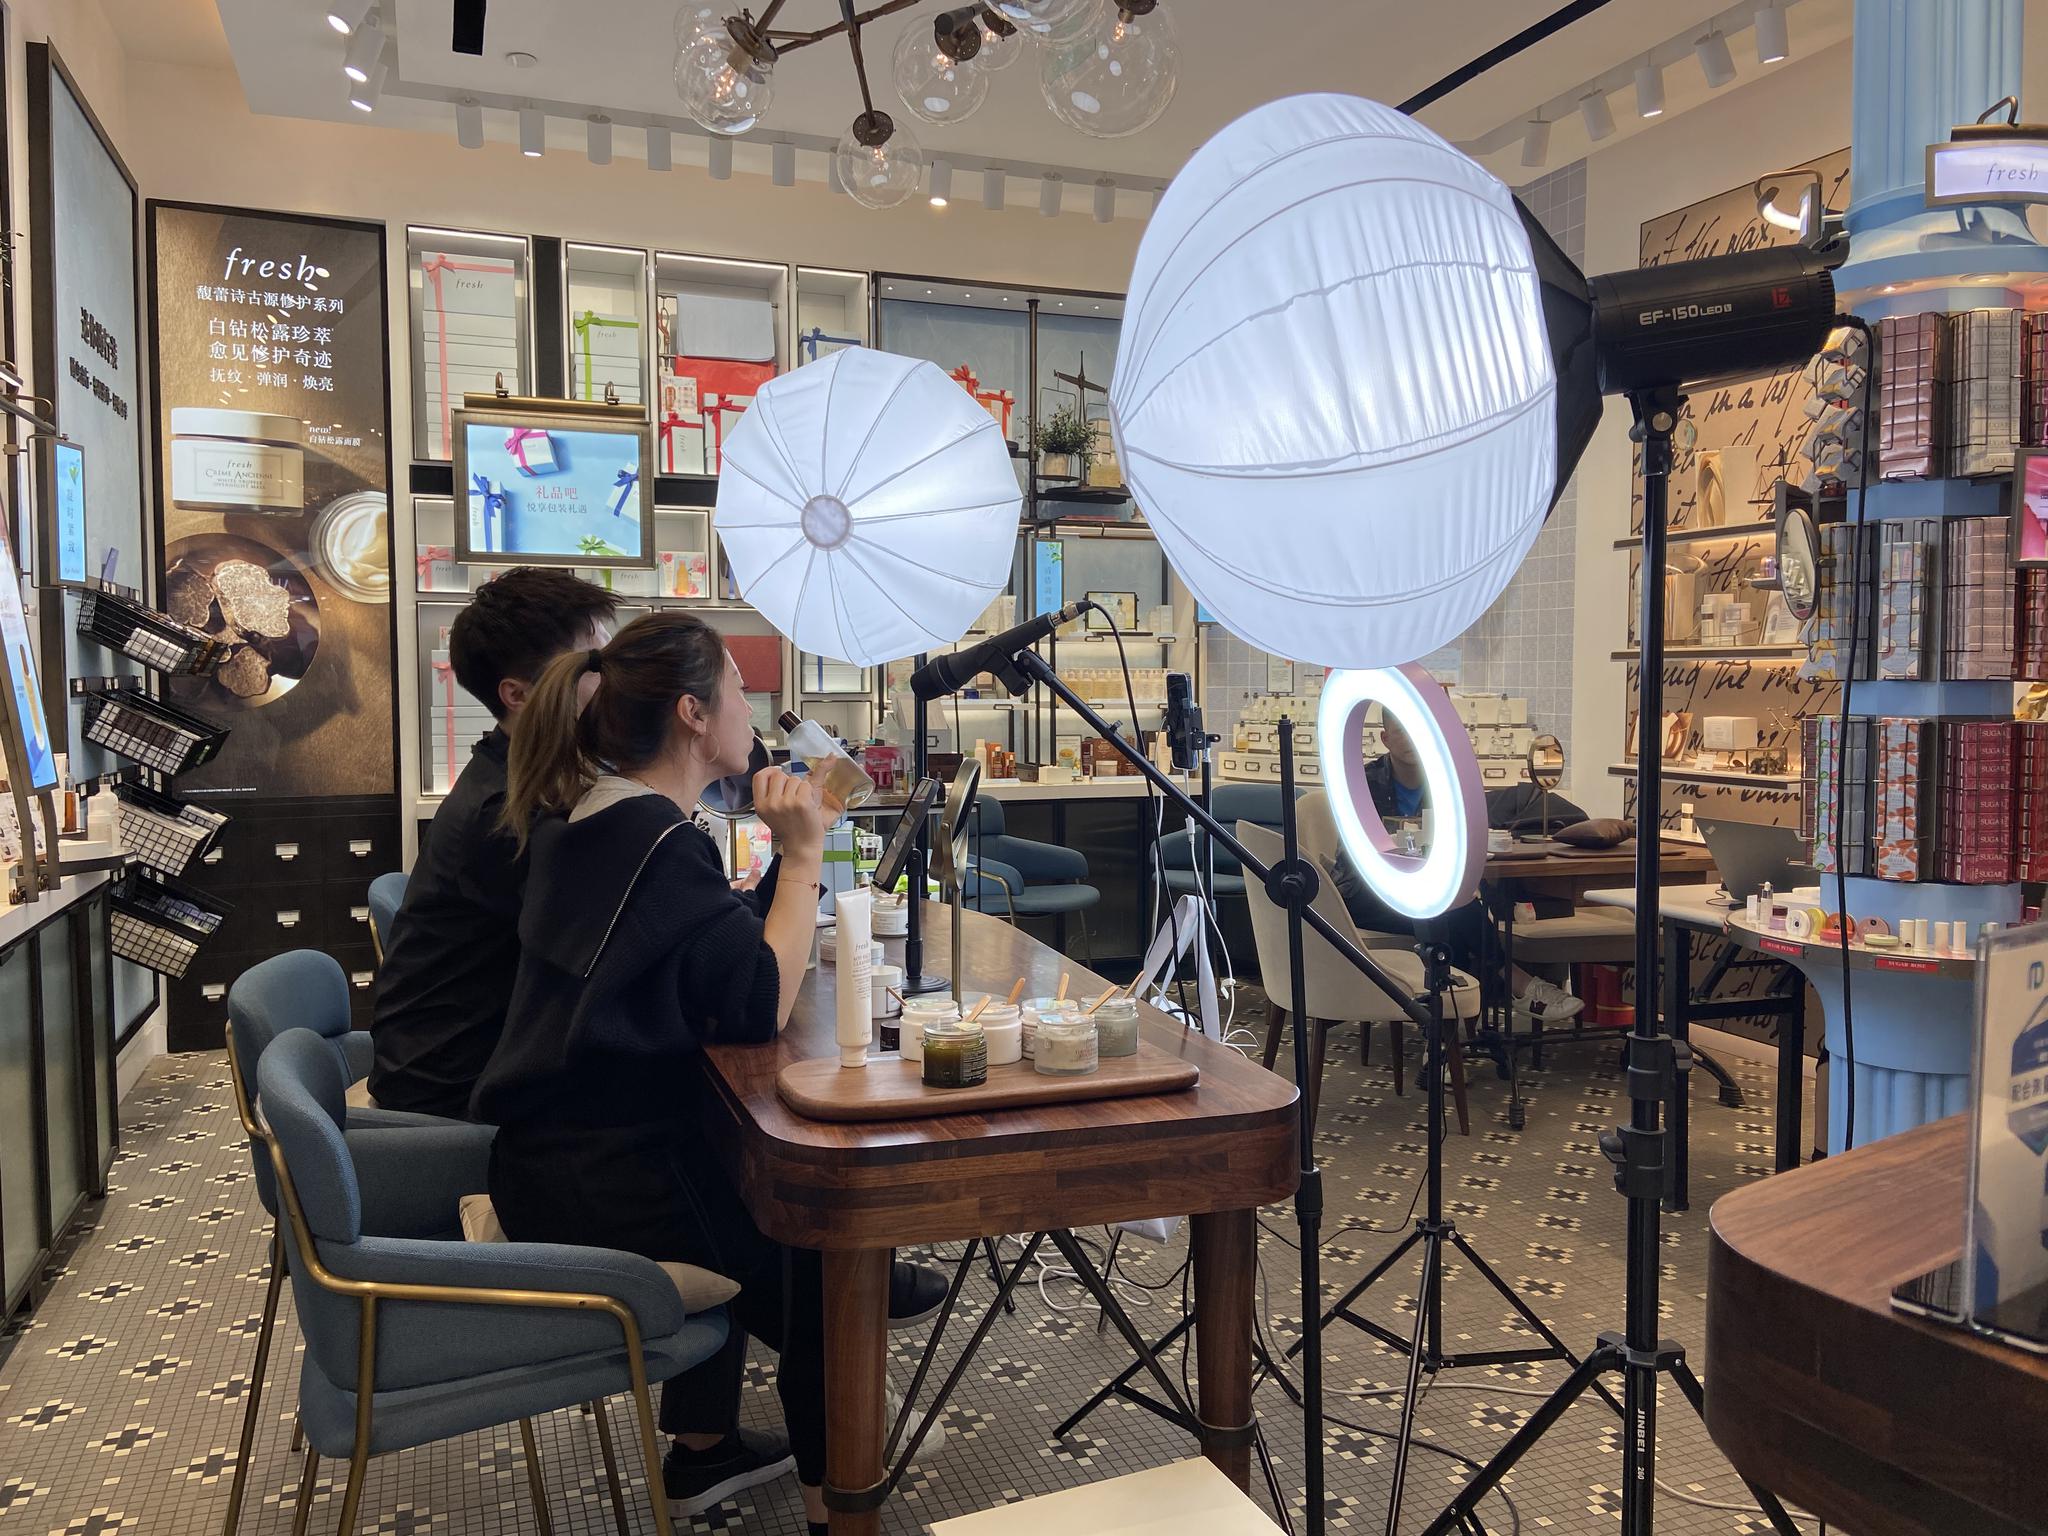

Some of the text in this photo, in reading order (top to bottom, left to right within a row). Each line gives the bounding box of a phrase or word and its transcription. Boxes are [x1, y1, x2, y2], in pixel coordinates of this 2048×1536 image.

[1987, 162, 2039, 185] fresh
[224, 247, 315, 282] fresh
[456, 278, 484, 289] fresh
[196, 285, 344, 315] 馥蕾诗古源修护系列
[209, 317, 333, 346] 白钻松露珍萃
[209, 340, 333, 370] 愈见修护奇迹
[209, 367, 334, 392] 抚纹 弹润 焕亮
[227, 460, 253, 469] fresh
[535, 485, 579, 500] 礼品吧
[1637, 1408, 1646, 1453] JINBEI
